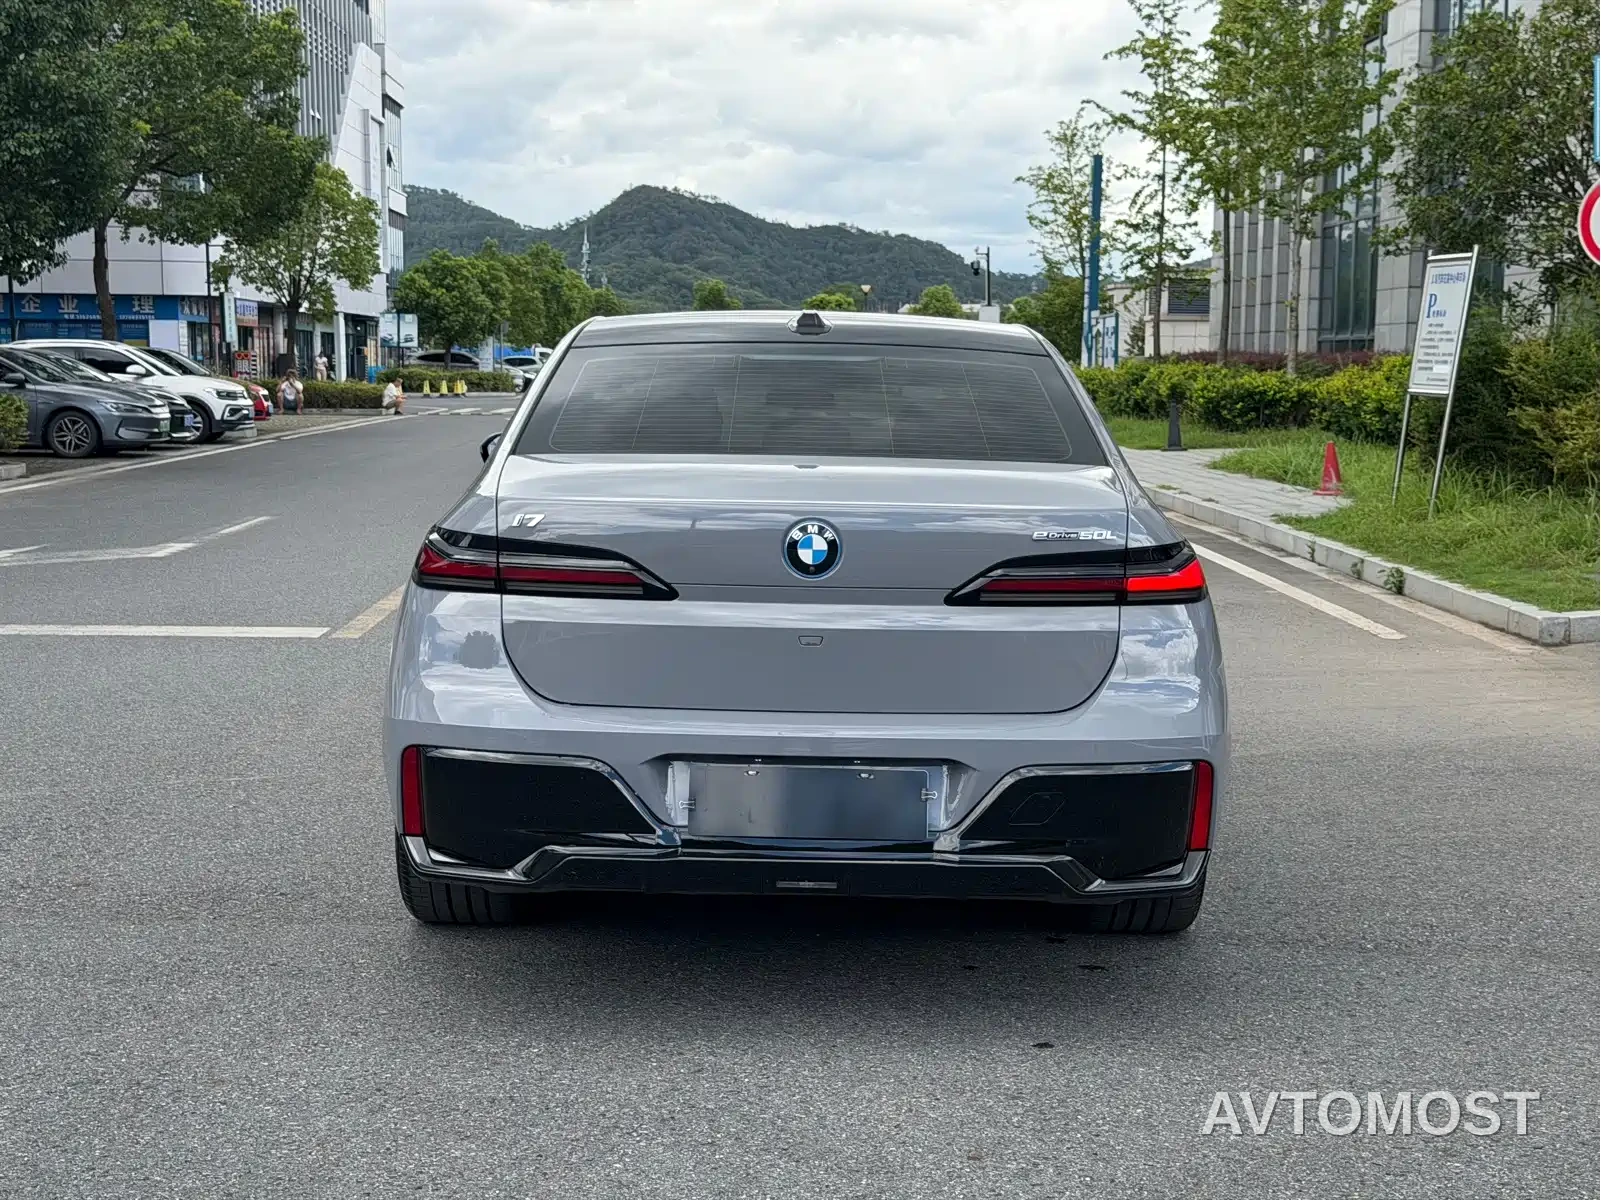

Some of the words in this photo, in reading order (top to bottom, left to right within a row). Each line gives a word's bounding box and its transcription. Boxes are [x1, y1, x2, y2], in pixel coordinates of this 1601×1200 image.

[1426, 293, 1438, 319] P
[511, 513, 546, 527] i7
[791, 524, 835, 541] BMW
